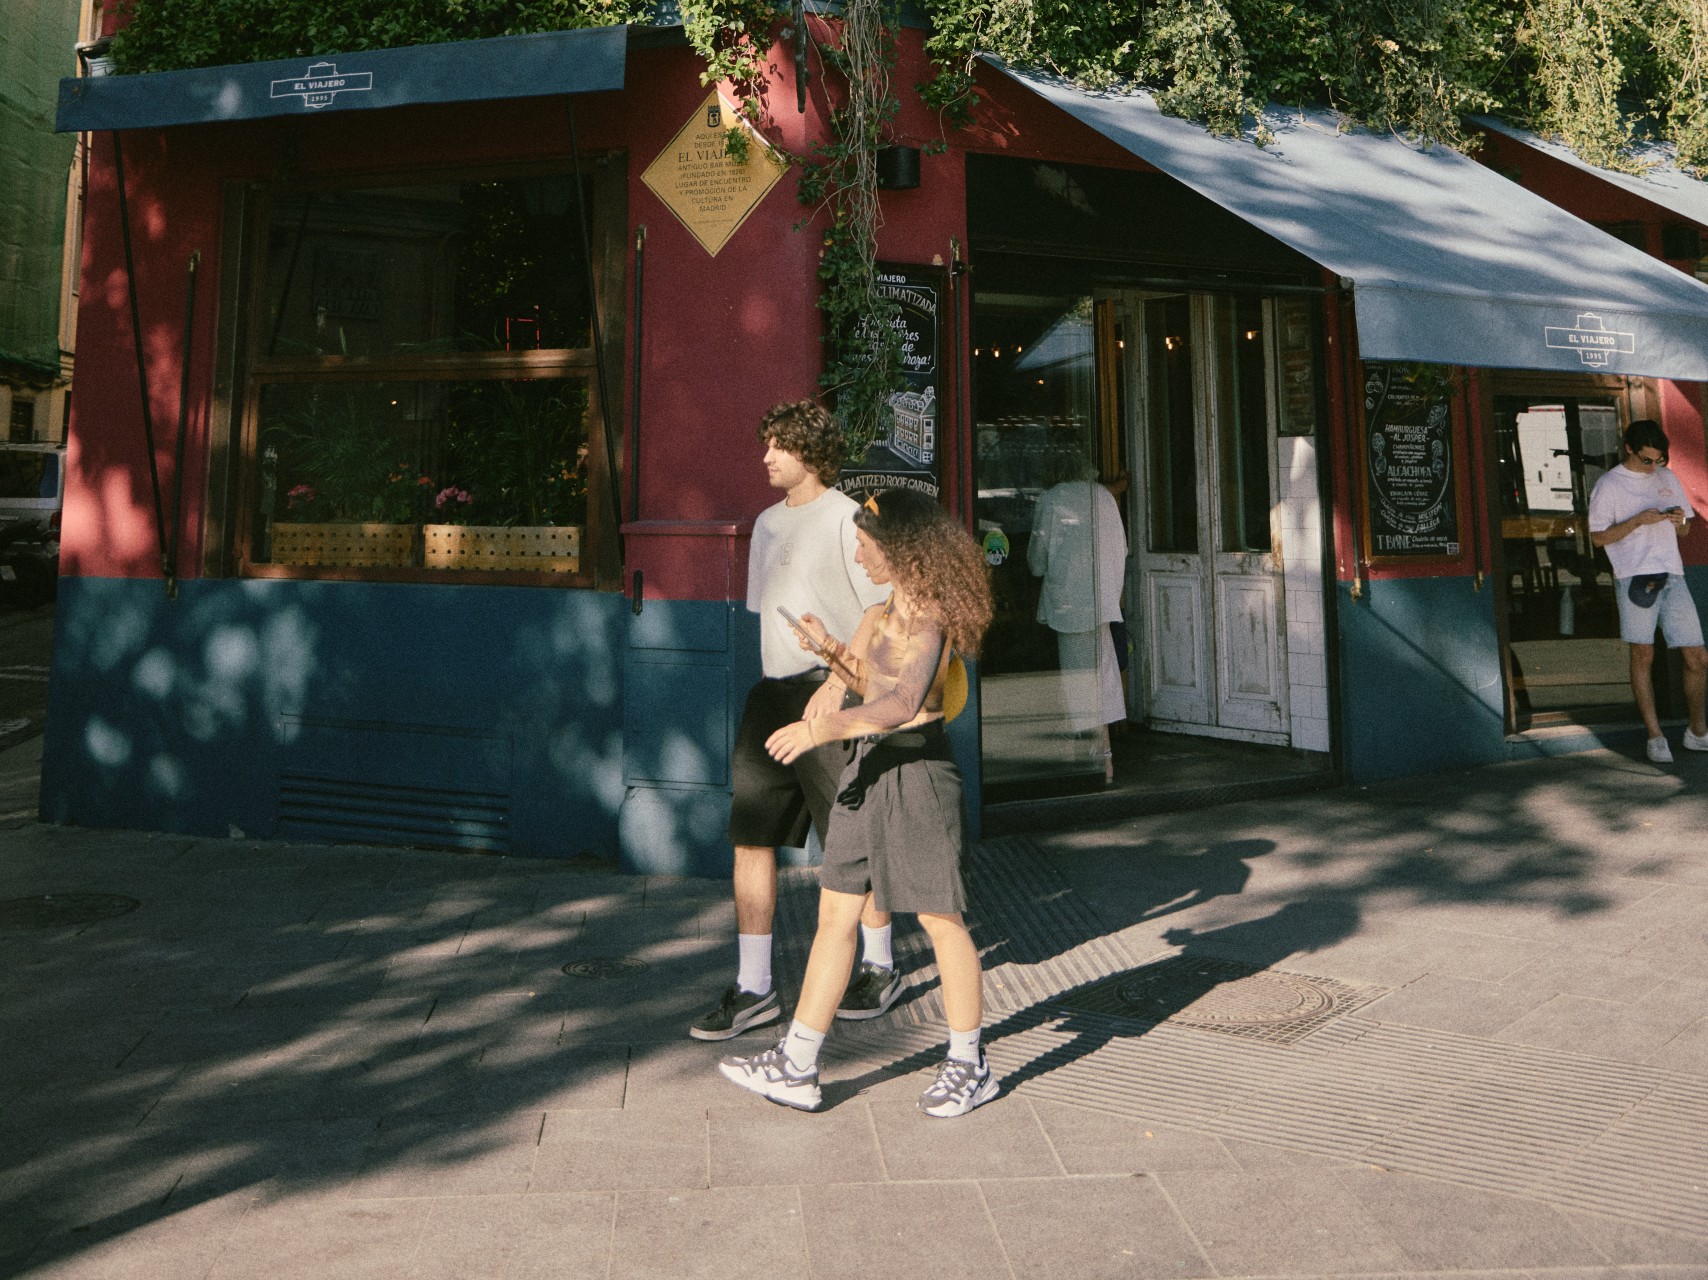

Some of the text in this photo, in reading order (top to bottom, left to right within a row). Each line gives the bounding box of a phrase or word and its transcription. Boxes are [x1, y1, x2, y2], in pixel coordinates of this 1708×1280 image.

[309, 80, 345, 89] VIAJERO
[694, 141, 715, 149] DESDE
[678, 152, 693, 163] EL
[678, 163, 708, 171] ANTIGUO
[710, 161, 723, 169] BAR
[675, 180, 698, 188] LUGAR
[710, 176, 751, 185] ENCUENTRO
[691, 196, 722, 204] CULTURA
[1568, 334, 1615, 345] EL VIAJERO
[902, 341, 916, 352] de
[1586, 352, 1602, 360] 1995
[1384, 424, 1428, 435] HAMBURGUESA
[1387, 465, 1433, 478] ALCACHOFA
[886, 474, 908, 489] ROOF
[907, 478, 940, 498] GARDEN
